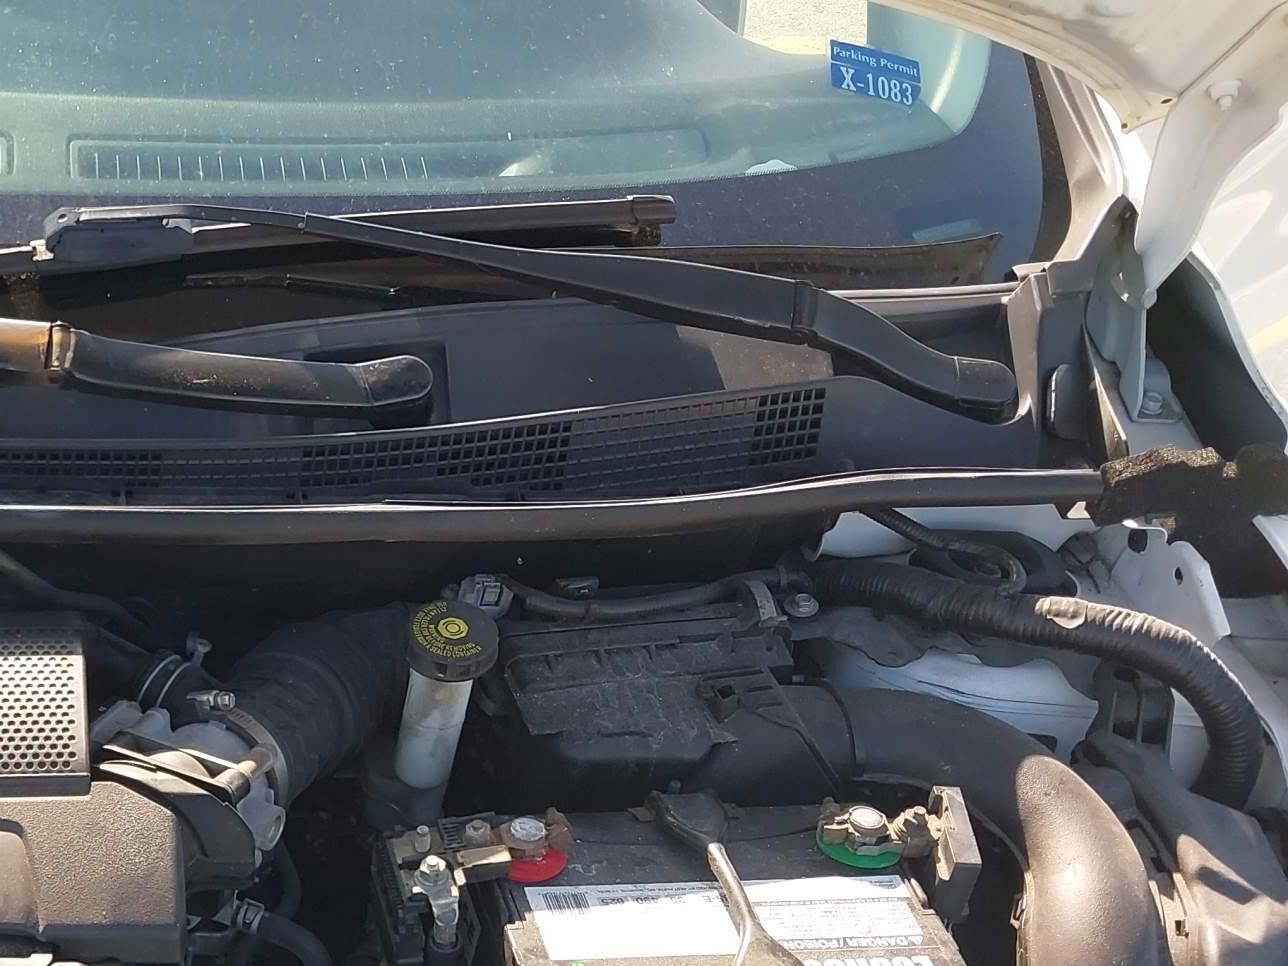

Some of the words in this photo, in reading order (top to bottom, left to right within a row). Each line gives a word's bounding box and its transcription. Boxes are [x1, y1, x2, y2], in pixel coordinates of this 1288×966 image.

[833, 46, 877, 67] Parking
[880, 58, 918, 77] Permit
[839, 66, 913, 106] X-1083
[845, 935, 910, 947] DANGER
